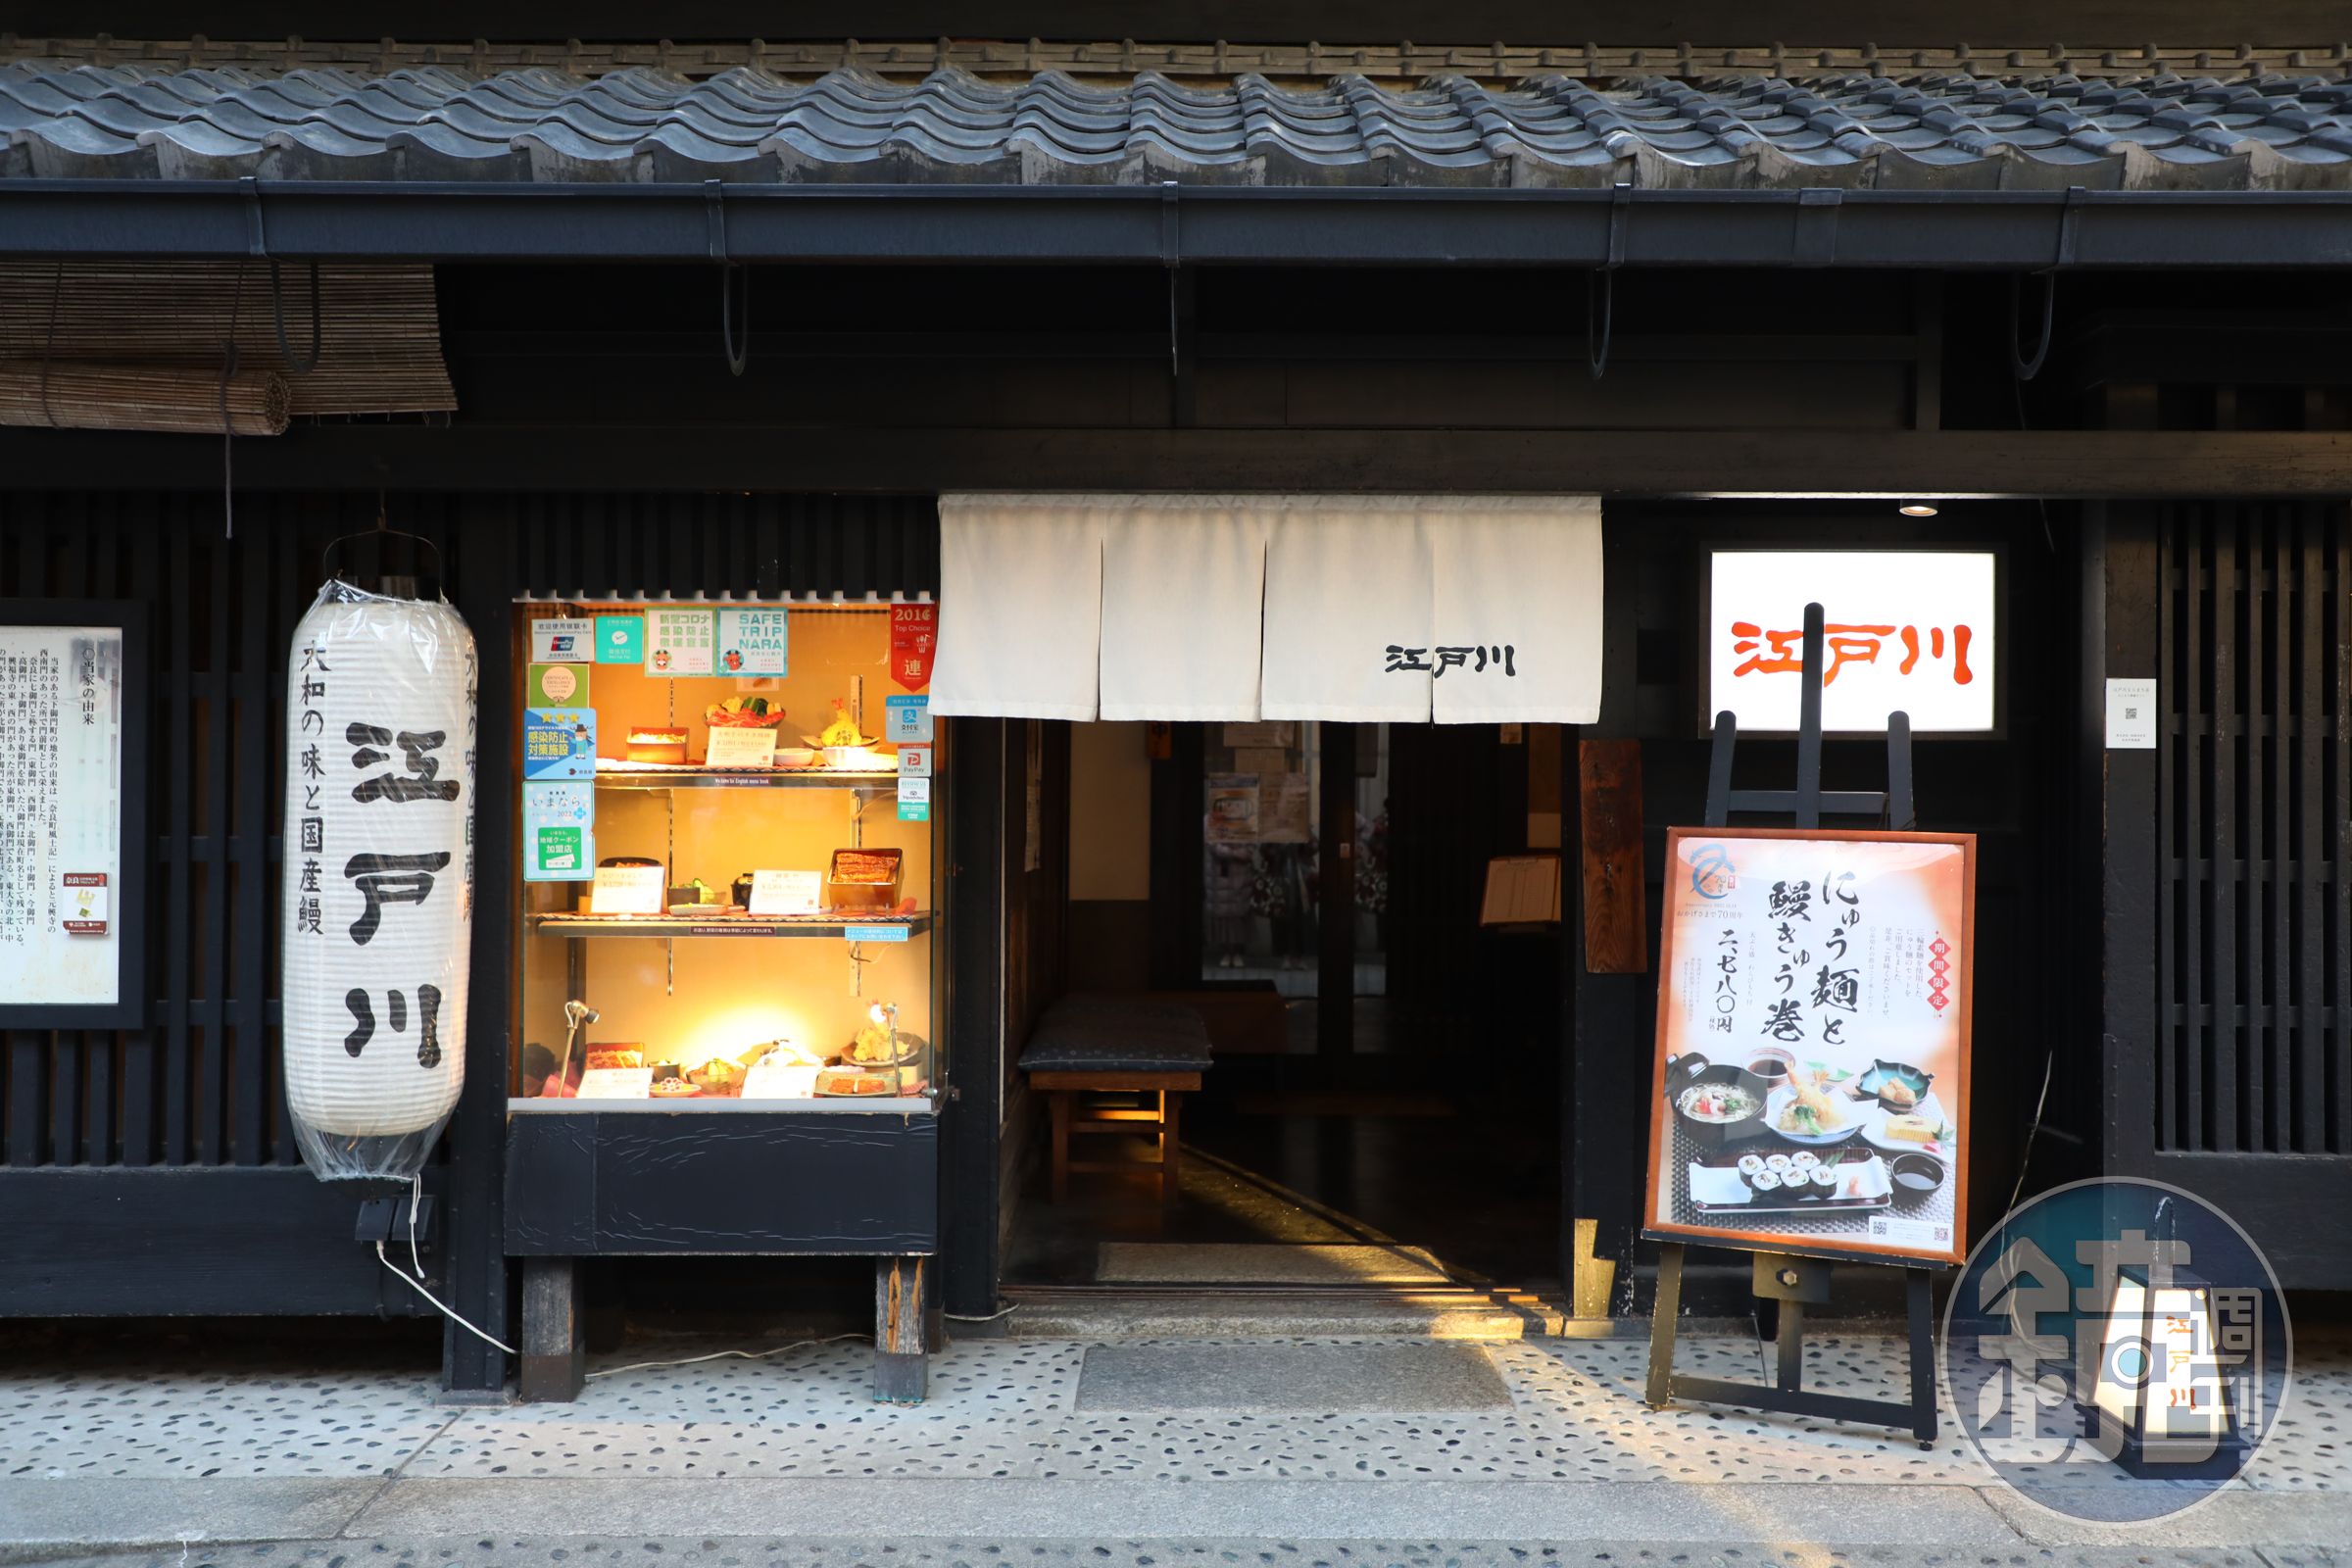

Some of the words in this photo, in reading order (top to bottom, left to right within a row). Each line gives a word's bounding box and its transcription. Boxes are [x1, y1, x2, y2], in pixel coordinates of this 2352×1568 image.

[739, 613, 782, 624] SAFE
[739, 626, 782, 637] TRIP
[739, 639, 782, 650] NARA
[1732, 621, 1973, 688] 江戸川
[1386, 645, 1516, 677] 江戸川
[528, 731, 568, 743] 感染防止
[528, 744, 568, 756] 対策施設
[297, 640, 331, 935] 大和の味と国産鰻
[533, 797, 580, 807] いまなら
[546, 845, 572, 854] 加盟店
[344, 721, 461, 1068] 江戸川
[1760, 880, 1812, 1043] 鰻きゅう巻
[1811, 870, 1860, 1046] にゅう麺と
[1933, 943, 1945, 1006] 期間限定
[2167, 1316, 2196, 1410] 江戸川
